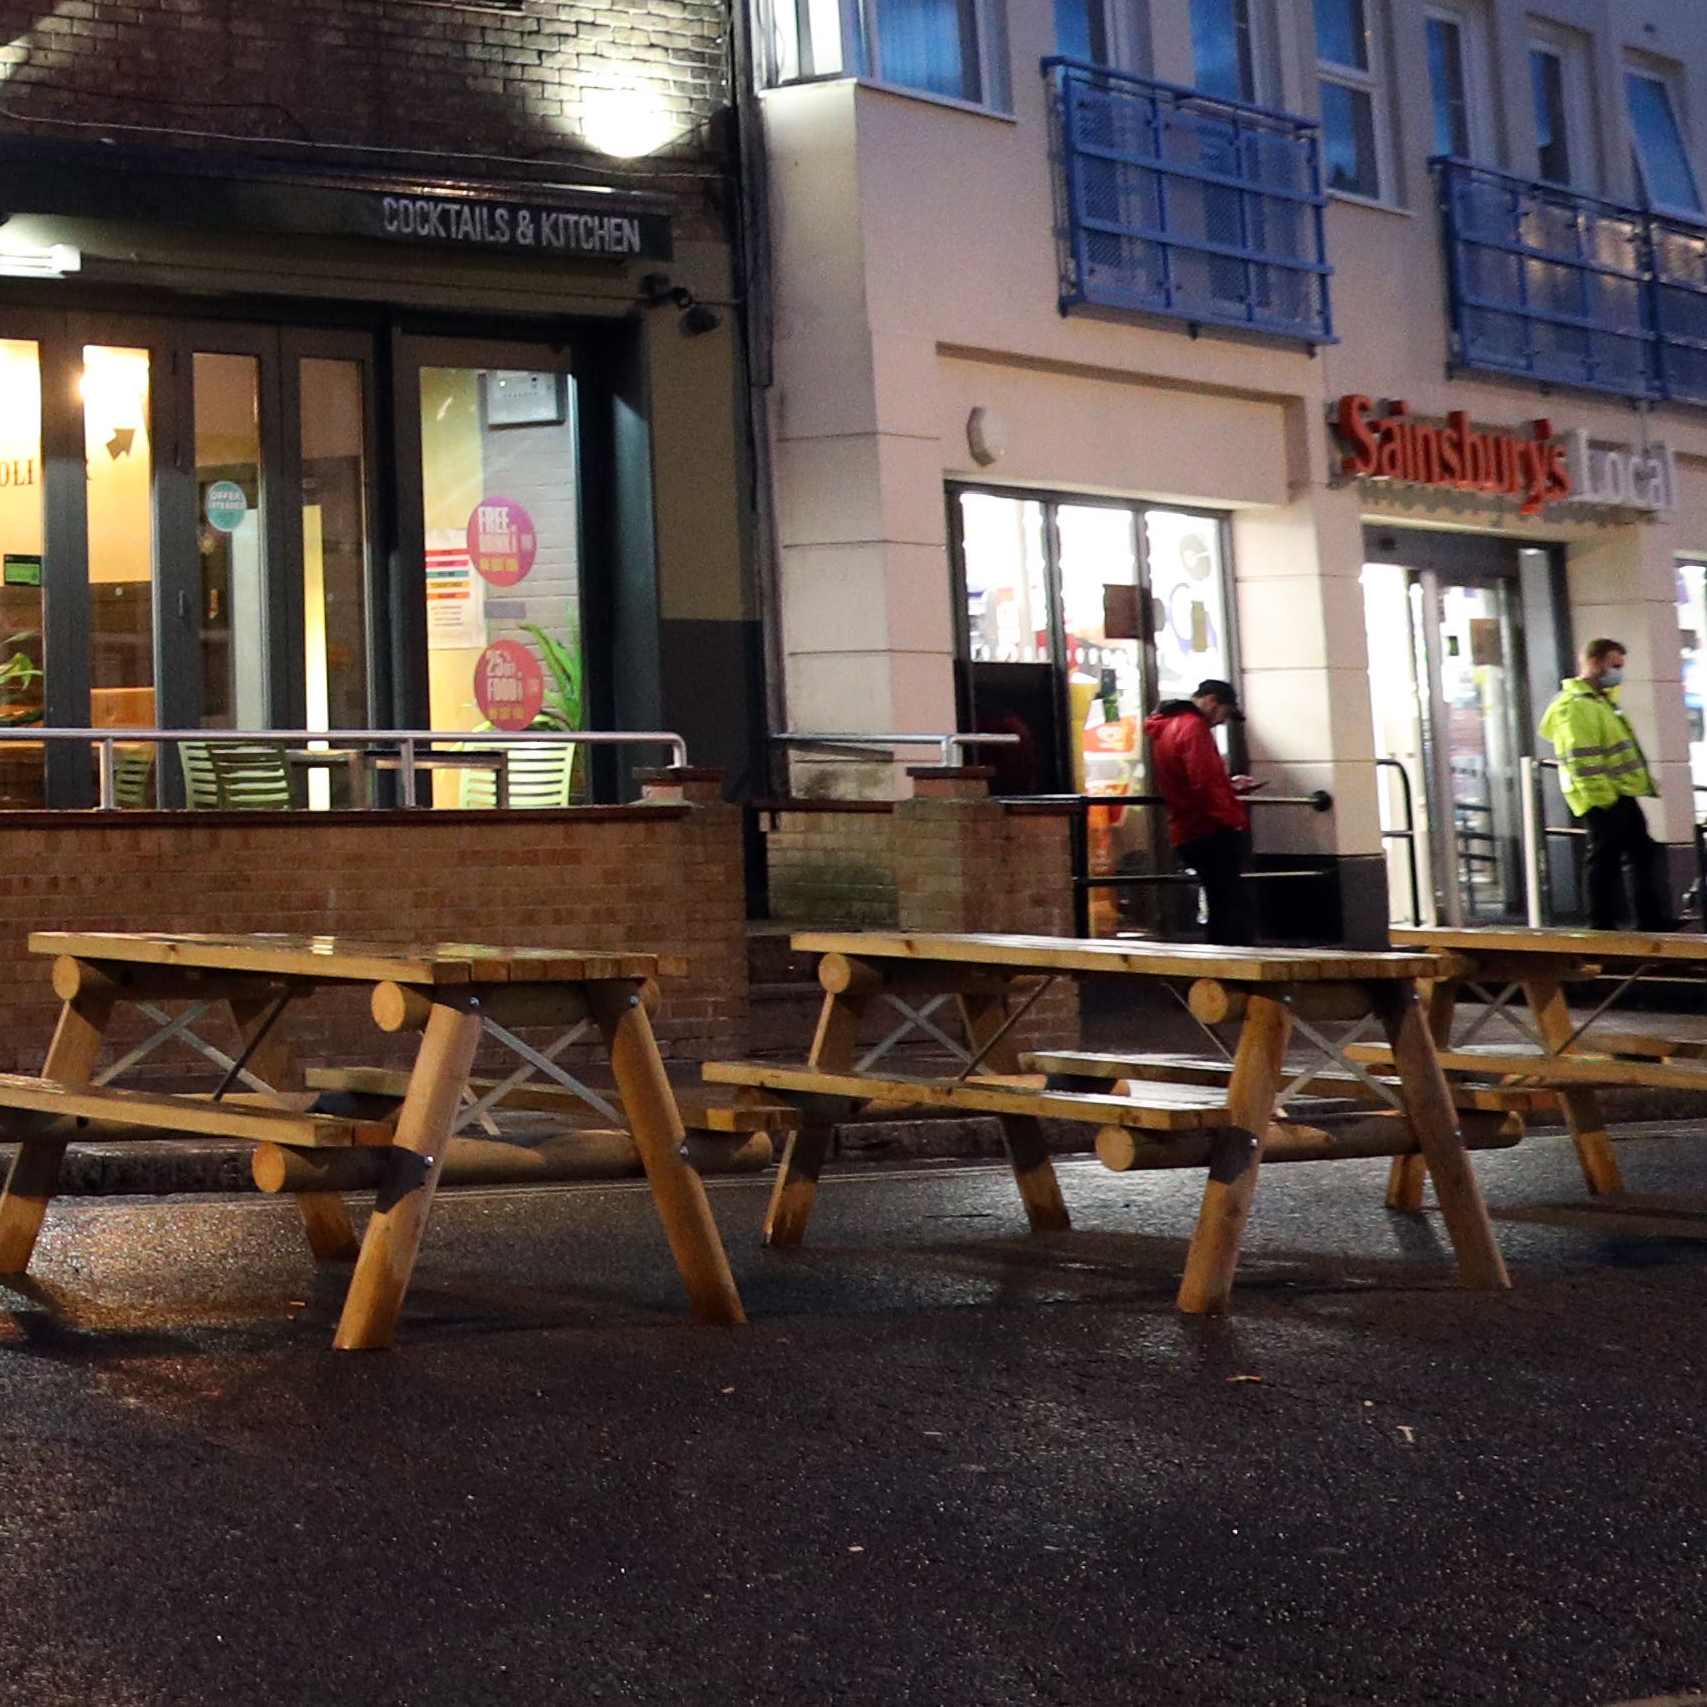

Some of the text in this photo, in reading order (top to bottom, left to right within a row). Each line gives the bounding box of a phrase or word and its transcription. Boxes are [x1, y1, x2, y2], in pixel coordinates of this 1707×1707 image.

[383, 196, 641, 253] COCKTAILS & KITCHEN
[1338, 394, 1674, 515] Sainsbury's Local
